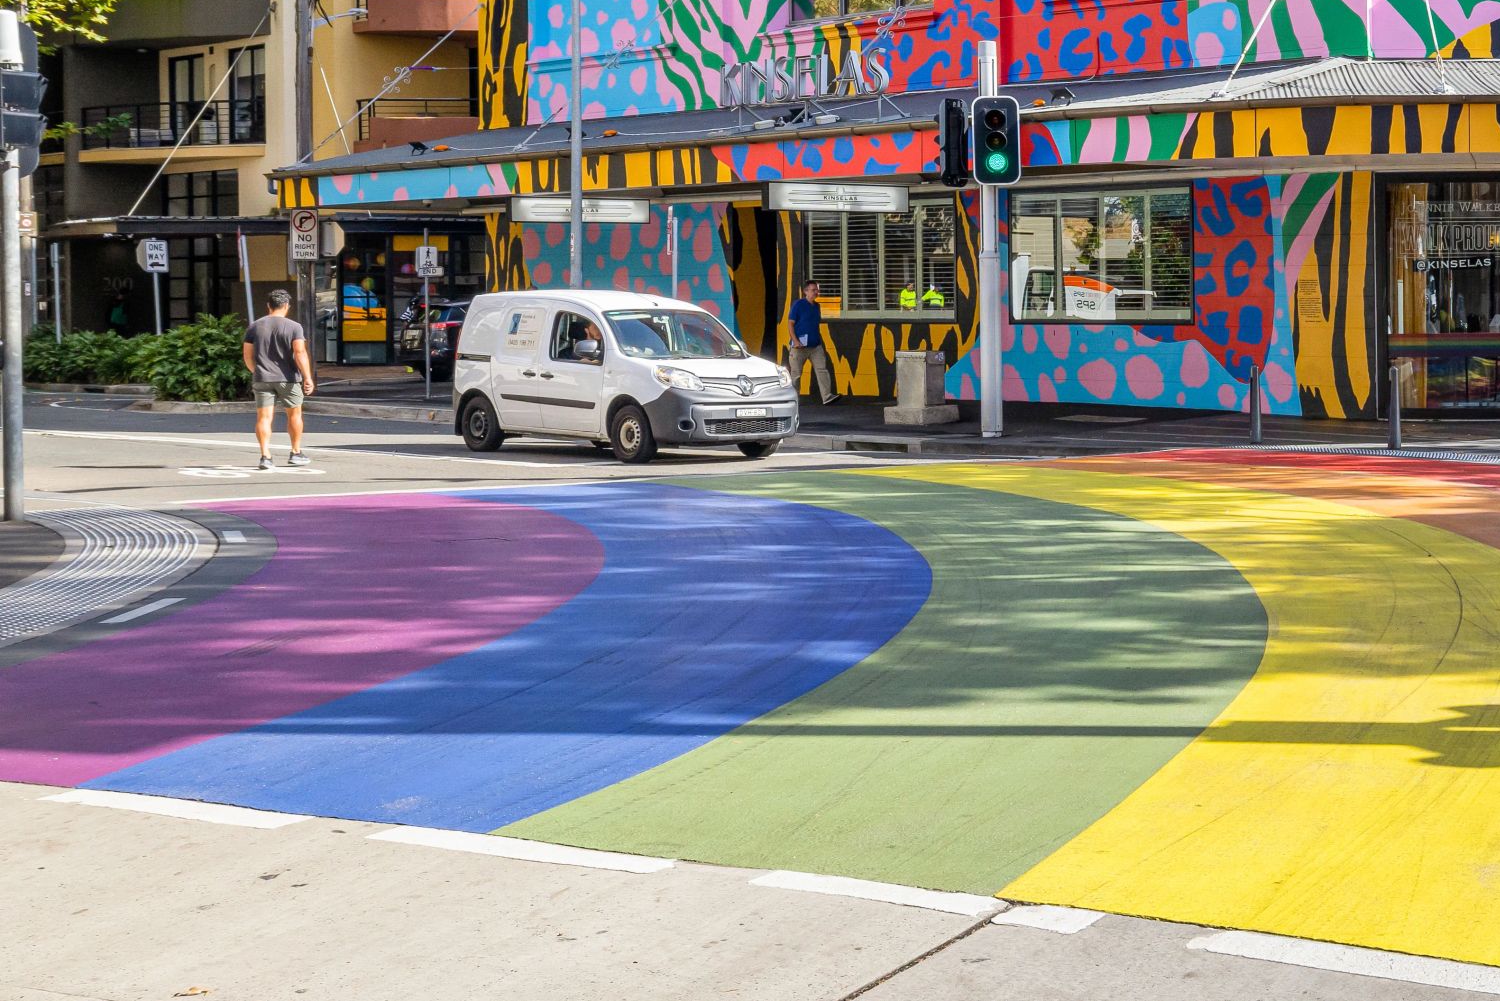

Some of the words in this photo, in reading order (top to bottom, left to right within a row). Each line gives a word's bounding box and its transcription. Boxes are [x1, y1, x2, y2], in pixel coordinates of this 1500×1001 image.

[720, 47, 891, 107] KINSELAS
[1401, 201, 1454, 214] JONNIE
[297, 234, 312, 242] NO
[148, 243, 164, 251] ONE
[1416, 258, 1492, 270] @KINSELAS
